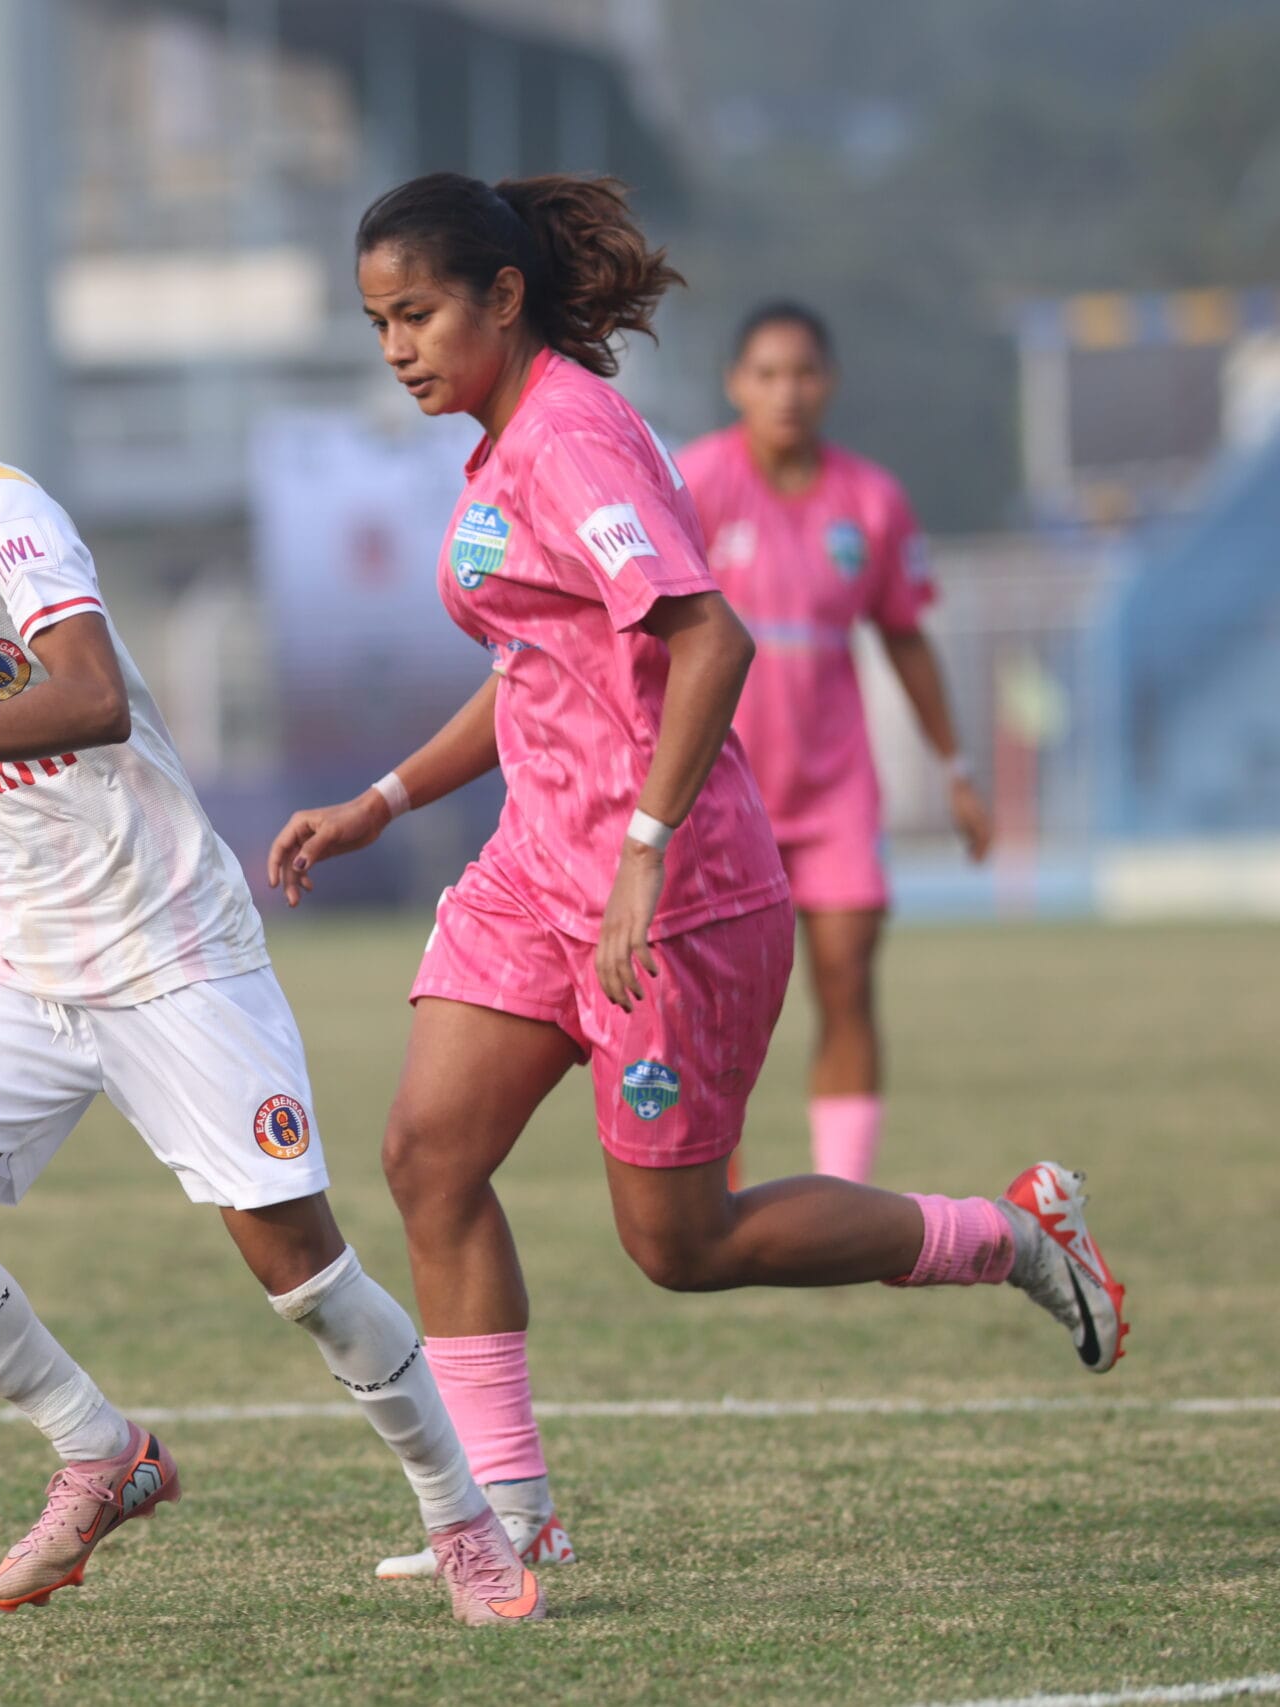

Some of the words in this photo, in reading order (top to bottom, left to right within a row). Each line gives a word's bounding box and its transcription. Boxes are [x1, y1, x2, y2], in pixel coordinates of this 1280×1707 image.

[604, 522, 647, 556] IWL
[637, 1065, 669, 1080] SESA
[256, 1103, 271, 1133] EAST
[272, 1096, 306, 1121] BENGAL
[285, 1146, 301, 1158] FC
